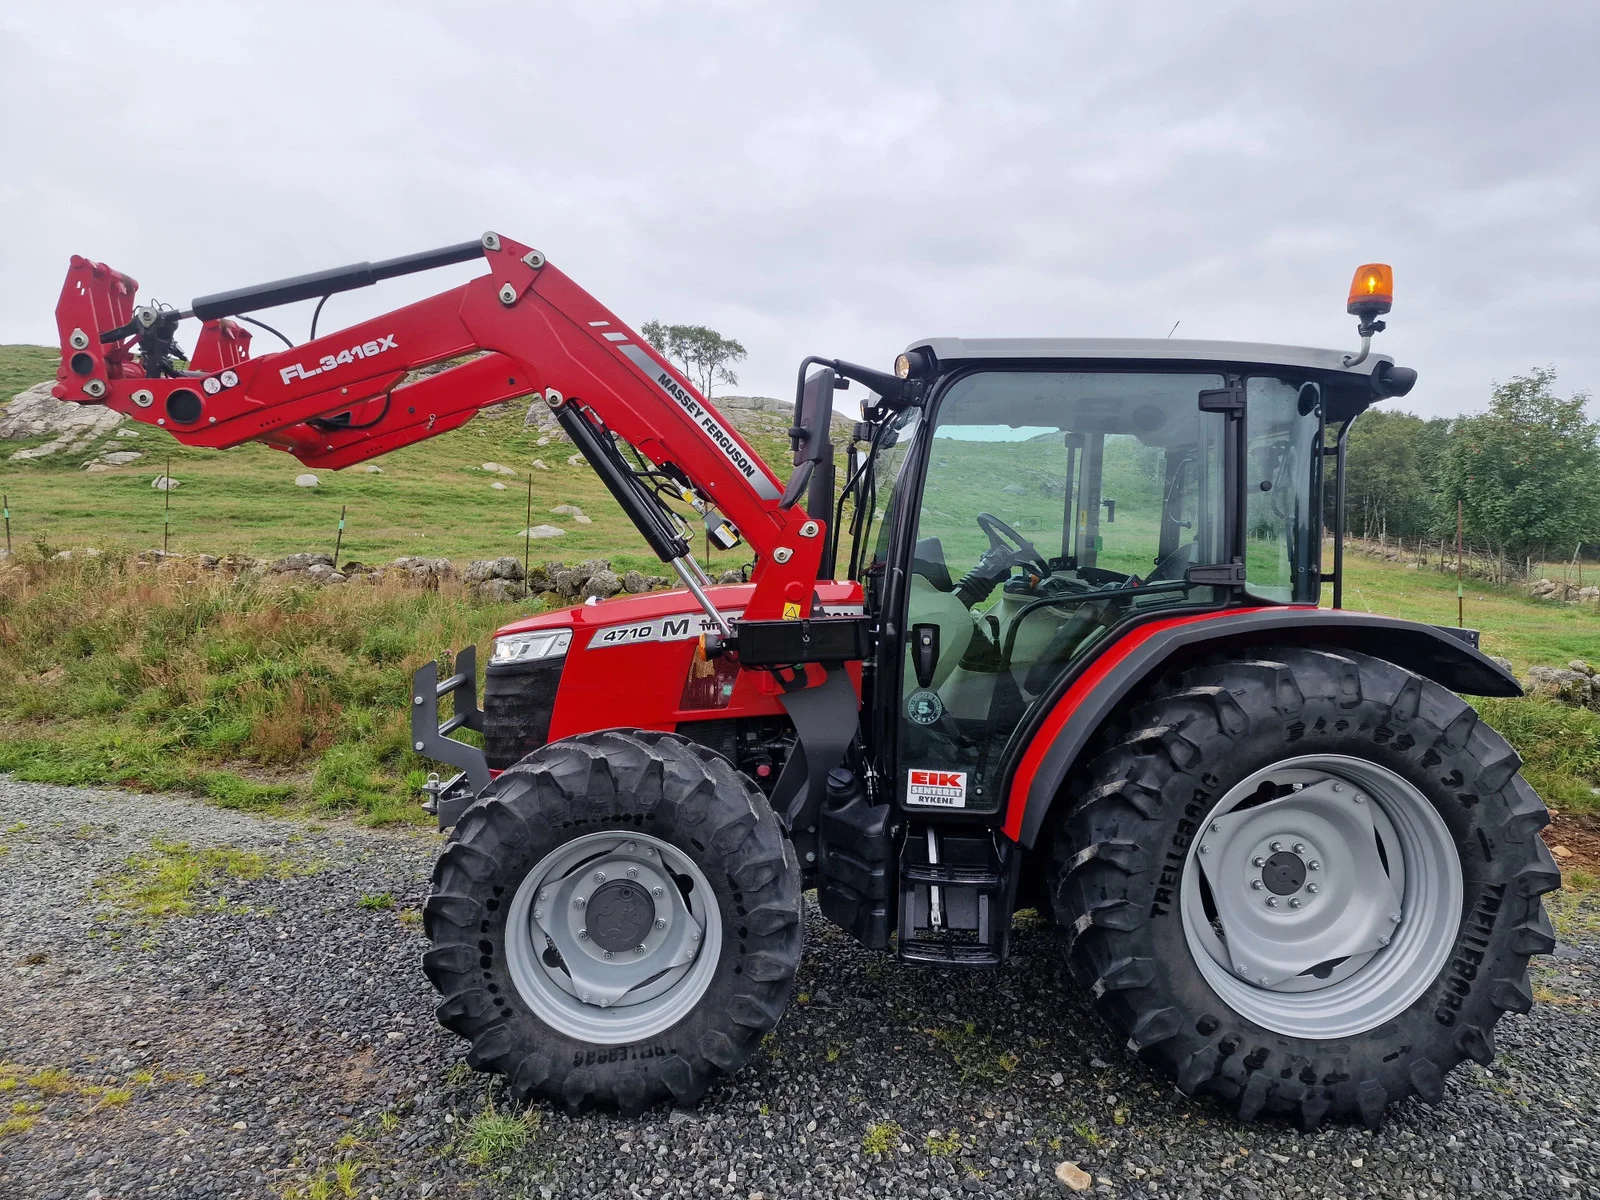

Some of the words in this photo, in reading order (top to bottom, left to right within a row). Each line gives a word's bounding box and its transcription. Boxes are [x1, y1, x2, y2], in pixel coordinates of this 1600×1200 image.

[279, 334, 399, 385] FL.3416X
[657, 373, 704, 418] MASSEY
[701, 416, 755, 478] FERGUSON
[603, 625, 652, 642] 4710
[662, 618, 689, 639] M
[911, 771, 963, 788] EIK
[911, 786, 962, 797] SENTERET
[918, 795, 955, 805] RYKENE
[1148, 772, 1221, 920] TRELLEBORG
[1434, 881, 1508, 1028] TRELLEBORG
